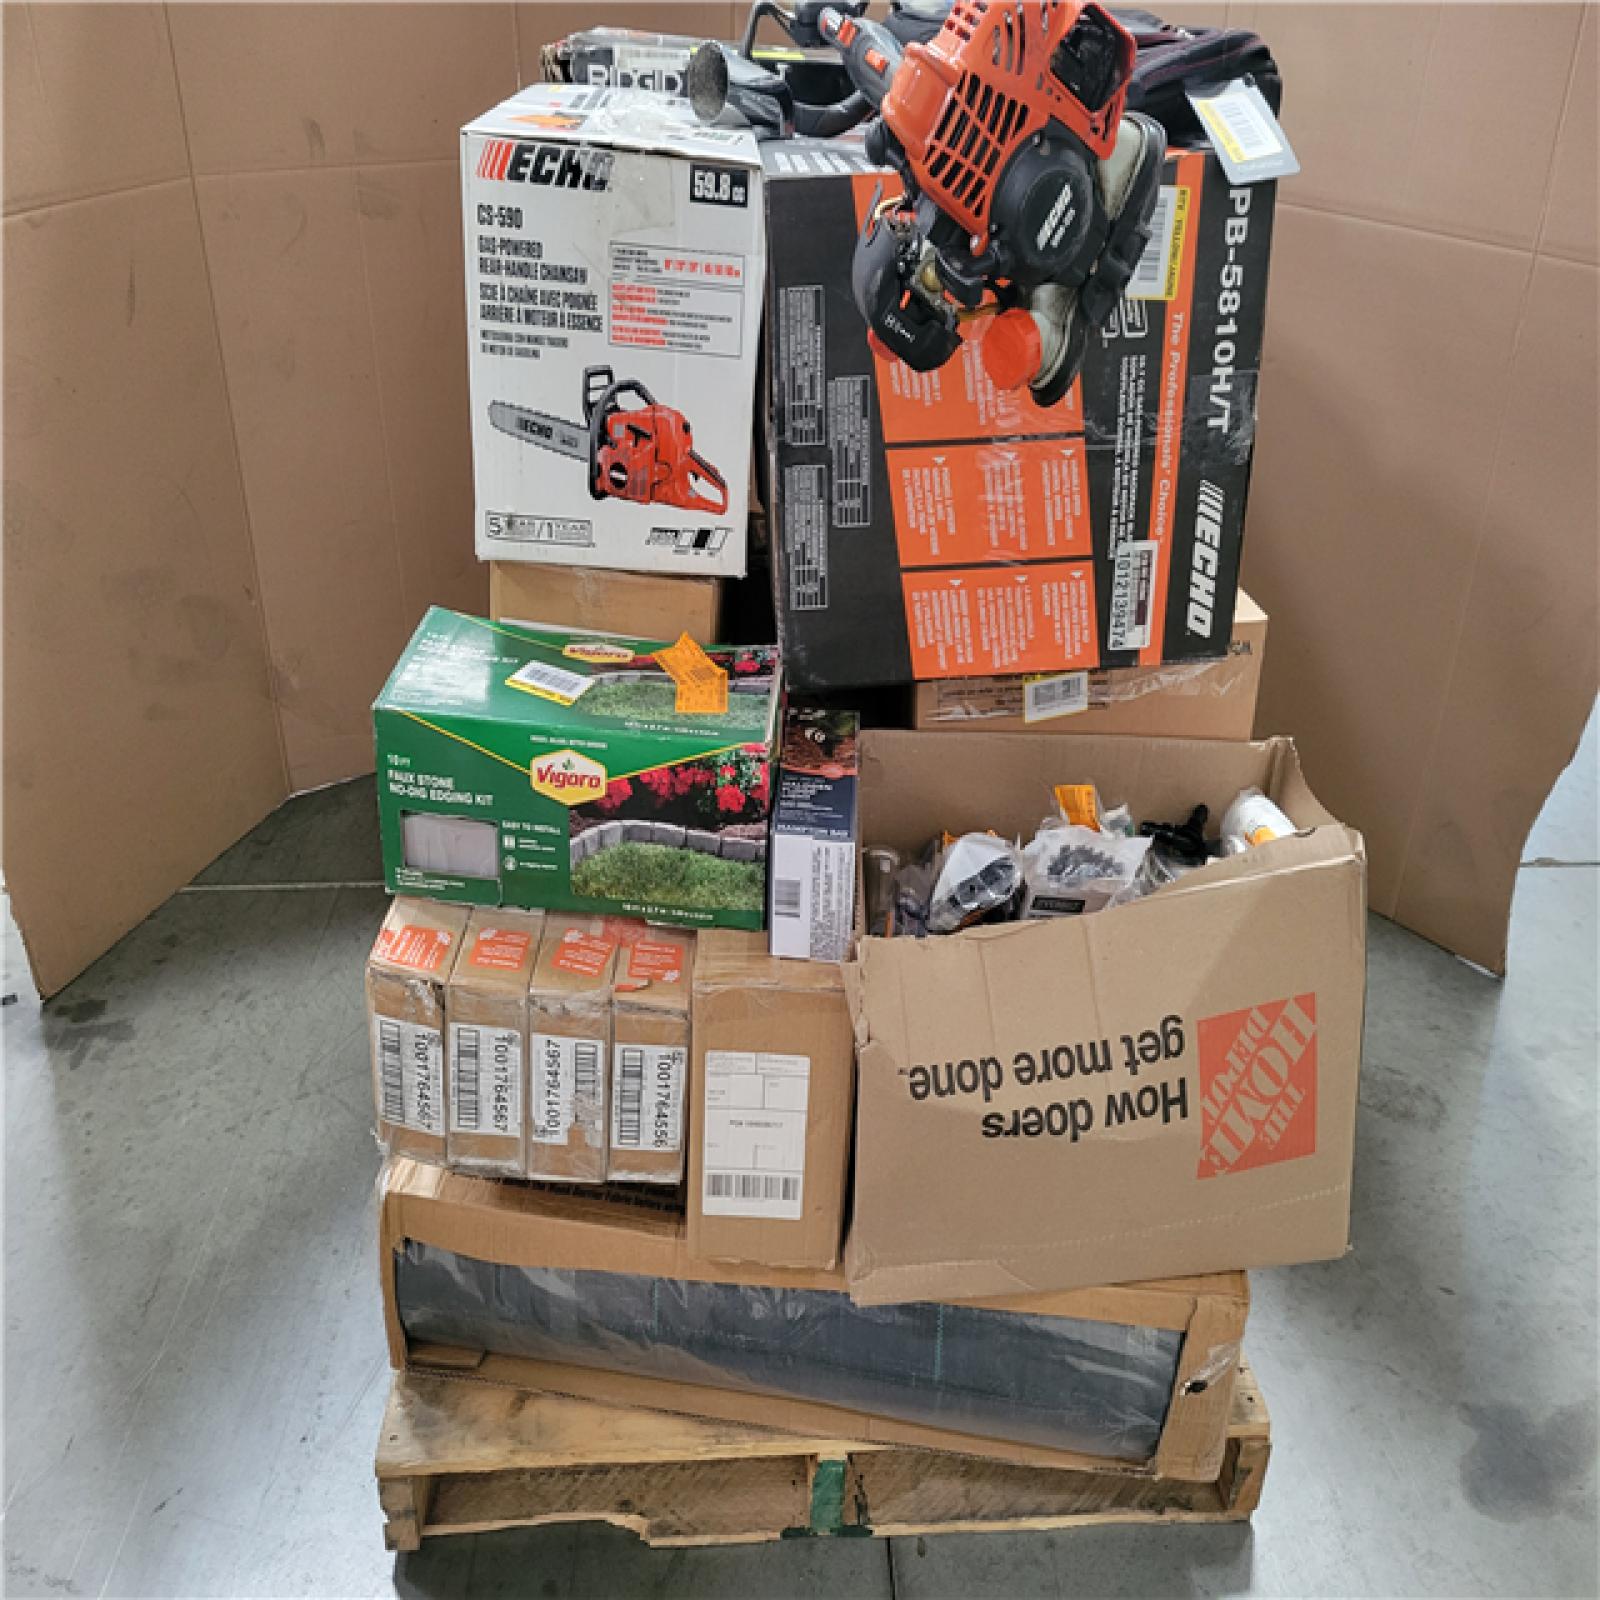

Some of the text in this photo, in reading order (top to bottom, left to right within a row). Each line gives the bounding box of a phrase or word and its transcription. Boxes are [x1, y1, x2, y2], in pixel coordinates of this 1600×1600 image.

[694, 170, 731, 200] 59.8
[477, 204, 523, 230] CS-590
[477, 235, 543, 259] GAS-POWERED
[479, 257, 538, 281] REAR-HANDLE
[540, 263, 588, 285] CHAINSAW
[1169, 312, 1184, 346] The
[1206, 187, 1252, 434] PB-5810H/T
[1186, 519, 1221, 639] ECHO
[536, 763, 602, 789] Vigoro
[1013, 1040, 1113, 1087] more
[1120, 1014, 1186, 1077] get
[1200, 1008, 1271, 1125] DEPOT
[981, 1078, 1189, 1143] How doers
[1200, 999, 1315, 1176] HOME
[1258, 1082, 1305, 1150] THE
